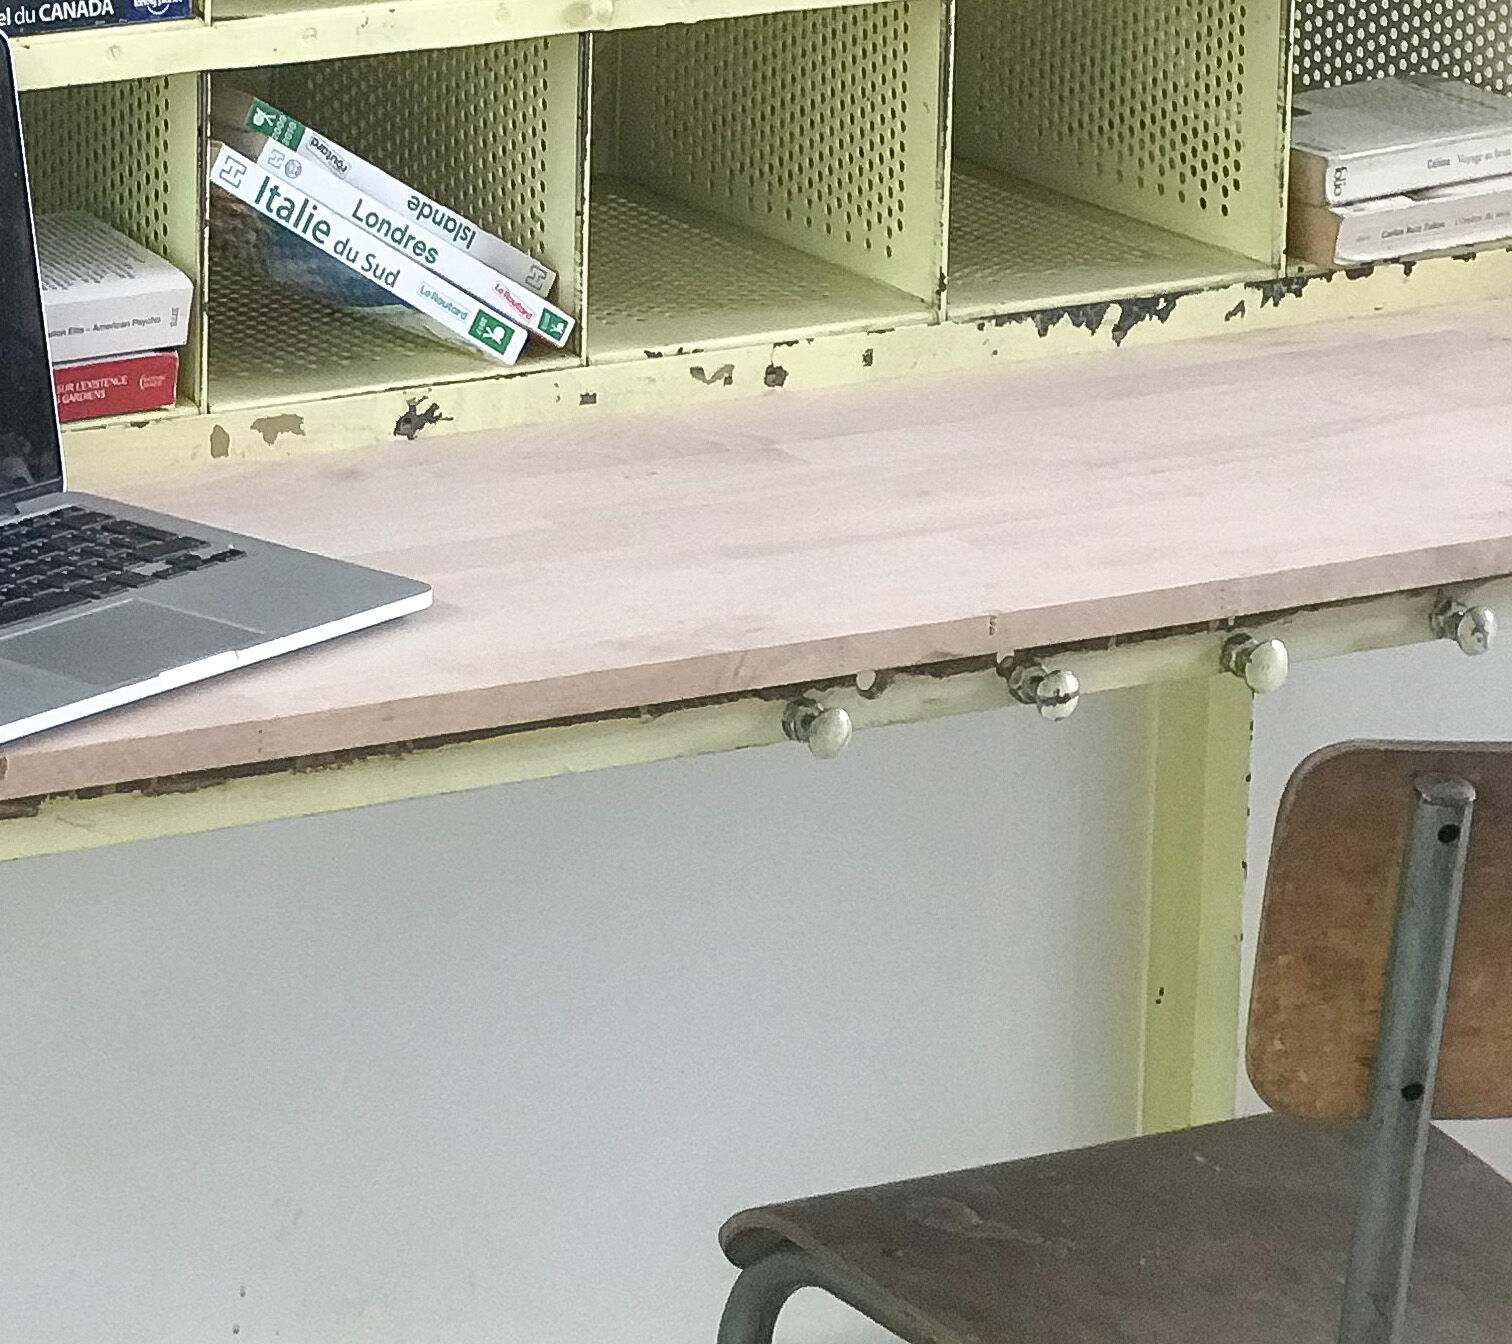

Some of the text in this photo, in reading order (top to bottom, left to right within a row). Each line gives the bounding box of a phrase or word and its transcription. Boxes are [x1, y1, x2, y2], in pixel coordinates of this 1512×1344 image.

[14, 5, 36, 25] du
[309, 136, 349, 173] routard
[254, 175, 401, 288] Italie du Sud
[352, 198, 439, 264] Londres
[406, 195, 477, 250] Islande
